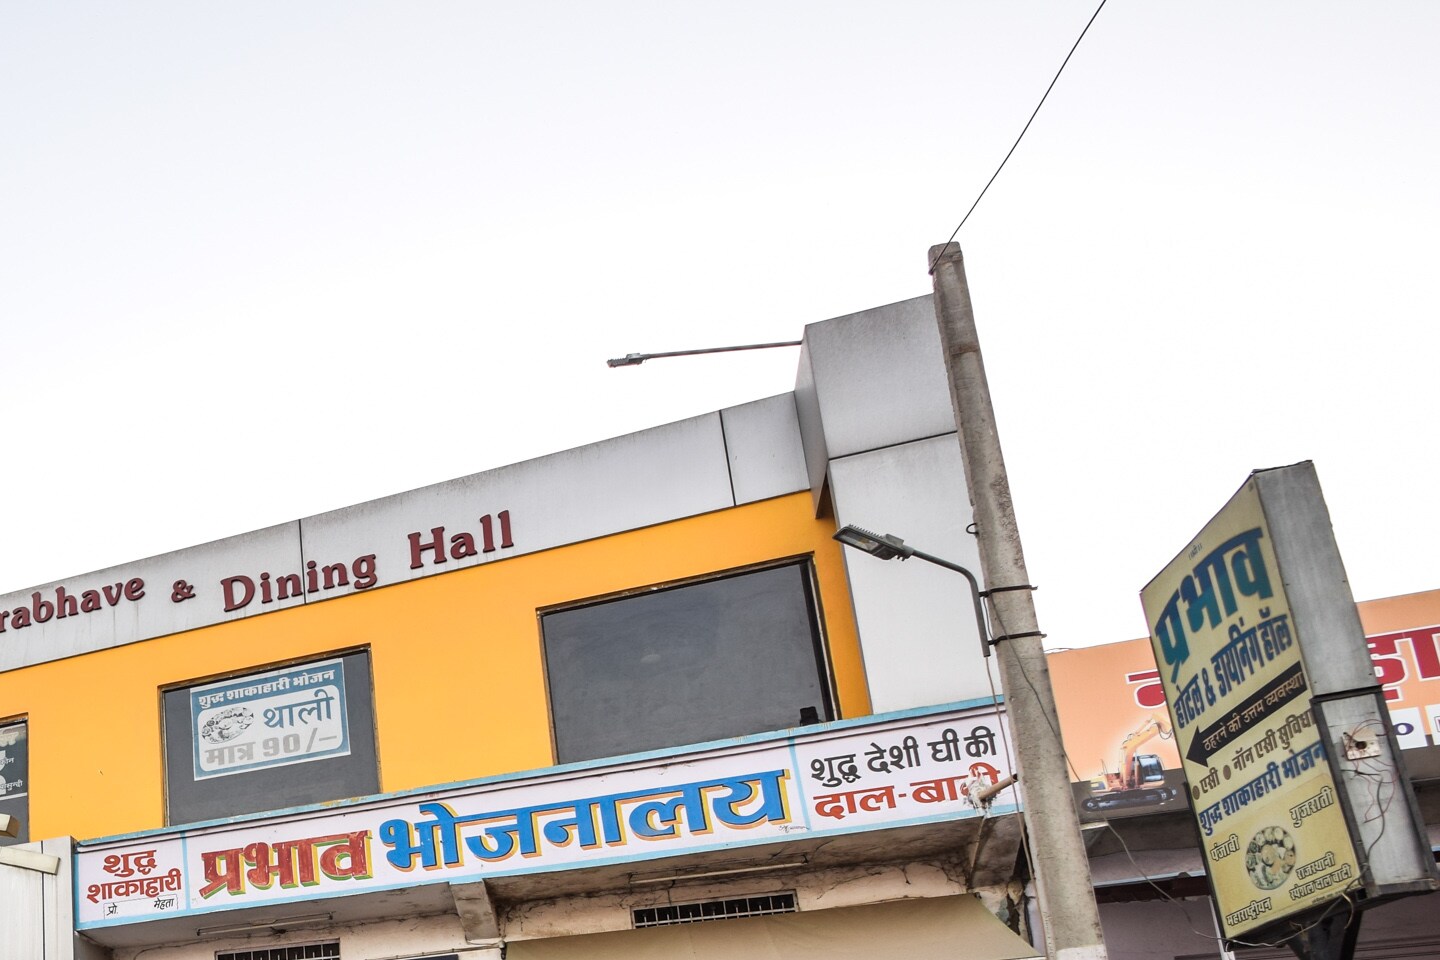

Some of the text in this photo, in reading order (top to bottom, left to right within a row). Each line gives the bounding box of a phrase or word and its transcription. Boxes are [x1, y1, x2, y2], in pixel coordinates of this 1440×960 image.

[171, 579, 195, 603] &
[220, 553, 377, 612] Dining
[407, 510, 514, 569] Hall
[1154, 527, 1274, 684] प्रभाव
[1172, 684, 1205, 729] होटल
[1202, 668, 1217, 707] &
[1258, 606, 1292, 661] हॉल
[198, 669, 335, 709] शुद्ध शाकाहारी भोजन
[263, 688, 335, 729] थाली
[1202, 671, 1305, 751] ठहरने की उत्तम व्यवस्था
[204, 741, 257, 766] मात्र
[810, 725, 998, 788] शुद्ध देशी घी की
[1200, 706, 1316, 795] एसी नॉन एसी सुविधा
[813, 761, 1001, 820] दाल-बाी
[1198, 740, 1328, 837] शुद्ध शाकाहारी भोजन
[1289, 785, 1334, 828] गुजराती
[199, 767, 791, 899] प्रभाव भोजनालय
[1210, 833, 1240, 862] पंजाबी
[102, 850, 158, 877] शुद्ध
[1288, 877, 1316, 901] स्पेशल
[1315, 874, 1332, 893] दाल
[1331, 862, 1353, 886] बाटी
[1296, 851, 1336, 880] राजस्थानी
[87, 867, 182, 904] शाकाहारी
[106, 897, 175, 916] प्रो. मेहता
[1225, 896, 1273, 928] महाराष्ट्रीयन
